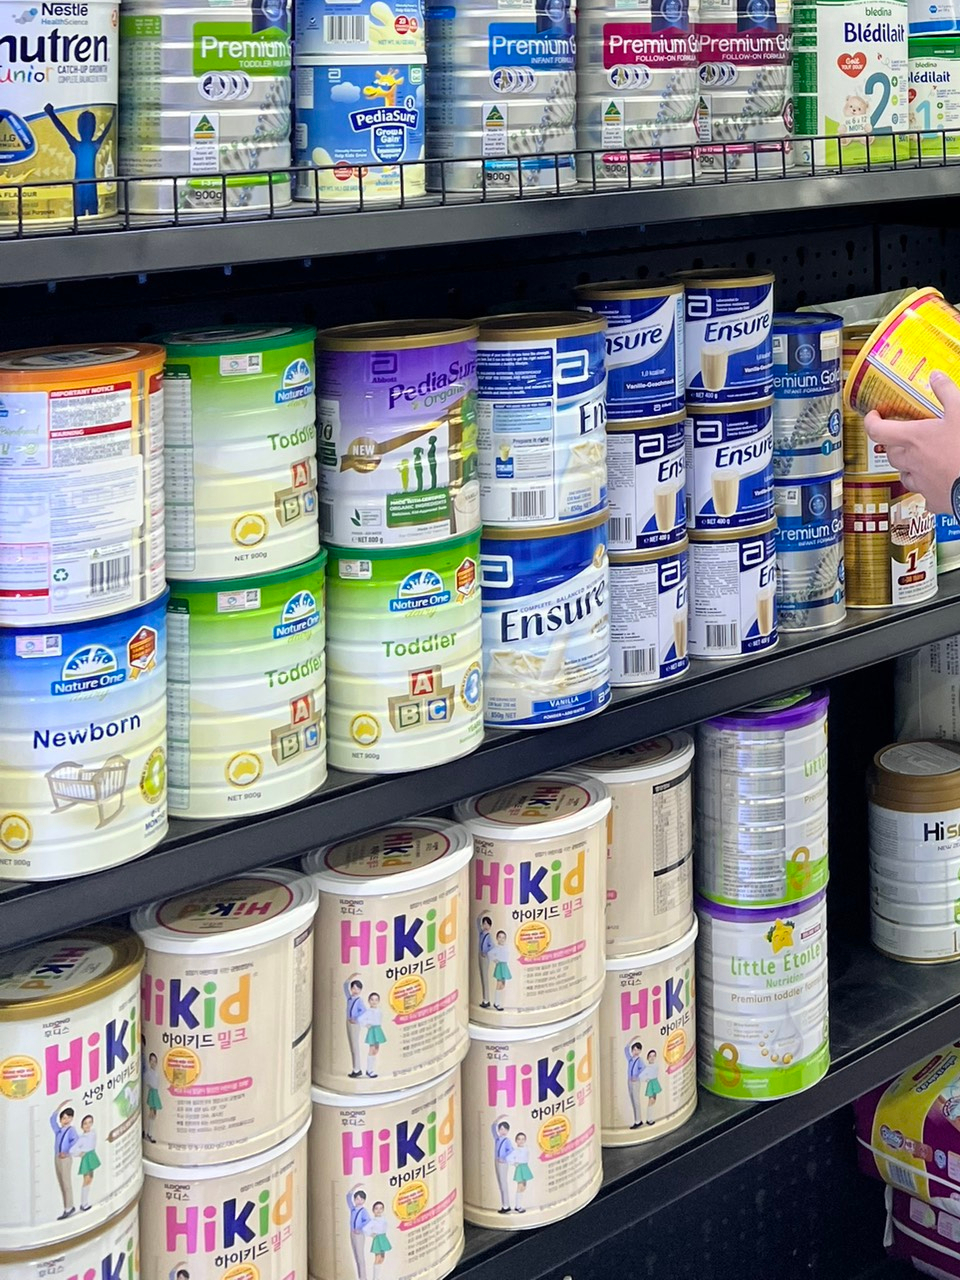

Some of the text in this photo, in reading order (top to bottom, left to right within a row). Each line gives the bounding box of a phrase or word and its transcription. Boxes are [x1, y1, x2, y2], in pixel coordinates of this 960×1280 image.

[41, 1, 88, 18] Nestlé
[700, 34, 773, 53] Premium
[844, 22, 905, 43] Blédilait
[0, 32, 108, 65] nutren
[200, 34, 288, 61] Premium
[492, 34, 569, 56] Premium
[609, 34, 686, 56] Premium
[239, 60, 273, 69] TODDLER
[635, 54, 675, 63] FOLLOW-ON
[356, 110, 416, 126] PediaSure
[916, 100, 937, 138] 1
[704, 313, 770, 343] Ensure
[51, 384, 114, 399] IMPORTANT NOTICE
[352, 445, 374, 456] NEW
[392, 594, 450, 609] Nature One
[501, 580, 604, 643] Ensure
[382, 631, 457, 659] Toddler
[53, 670, 125, 695] Nature One
[550, 696, 579, 707] VANILLA
[32, 713, 142, 750] Newborn
[924, 822, 944, 841] Hi
[474, 851, 586, 907] HiKid
[511, 899, 584, 922] 하이키드 밀크
[338, 894, 458, 966] HiKid
[385, 947, 457, 982] 하이키드 밀크
[730, 943, 821, 977] little Étoile
[731, 987, 804, 1004] Premium toddler
[162, 1028, 248, 1050] 하이키드 밀크
[486, 1034, 593, 1109] HiKid
[82, 1084, 105, 1106] 산양
[341, 1102, 457, 1178] HiKid
[166, 1171, 295, 1255] HiKid
[215, 1245, 268, 1269] 하이키드
